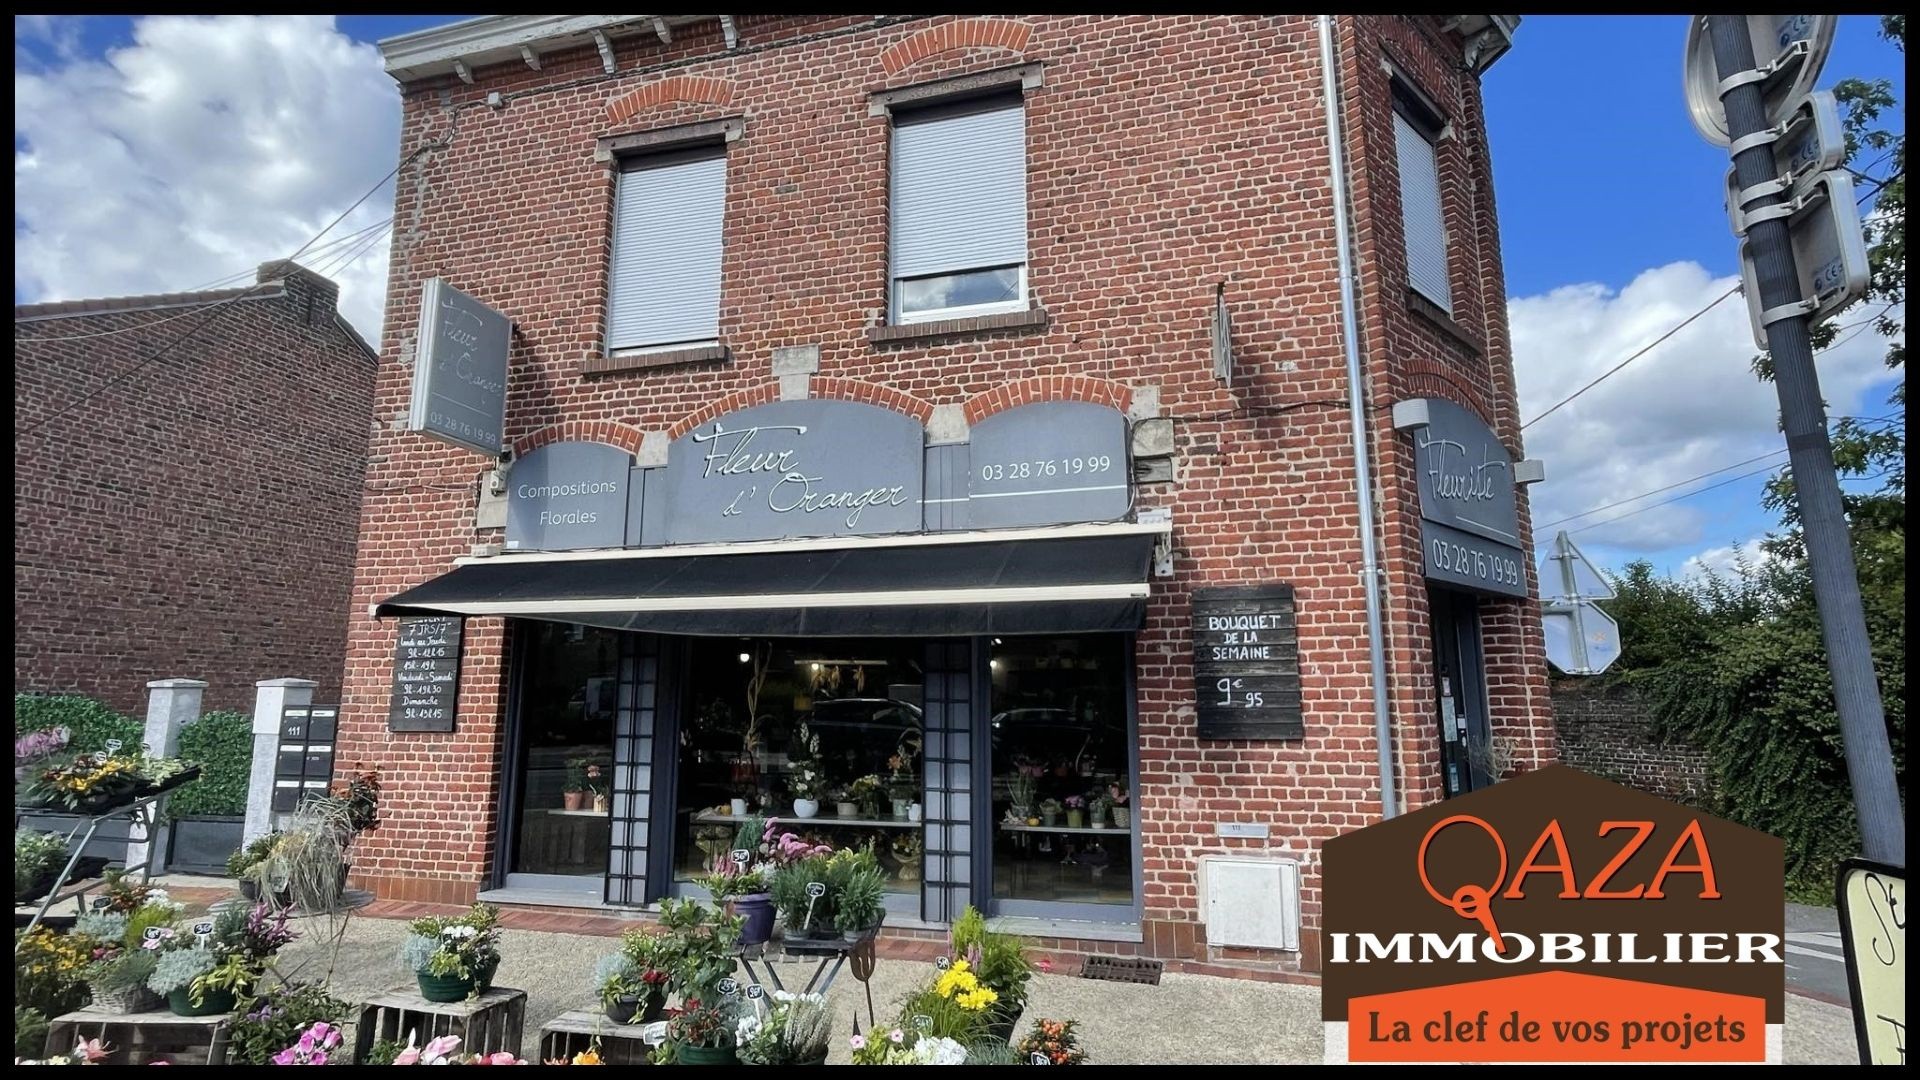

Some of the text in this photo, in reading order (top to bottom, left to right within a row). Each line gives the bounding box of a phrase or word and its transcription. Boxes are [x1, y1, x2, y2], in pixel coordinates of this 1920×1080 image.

[430, 411, 497, 445] 03 28 76 19 99
[693, 422, 807, 478] Fleur
[982, 456, 1110, 480] 03 28 76 19 99
[518, 479, 616, 500] Compositions
[768, 472, 908, 528] Oranger
[540, 509, 597, 526] Florales
[1433, 539, 1518, 586] 03 28 76 19 99
[408, 624, 416, 636] 7
[1209, 615, 1281, 630] BOUQUET
[1224, 631, 1258, 644] DE LA
[1212, 646, 1270, 660] SEMAINE
[1245, 692, 1264, 708] 95
[288, 726, 300, 736] 111
